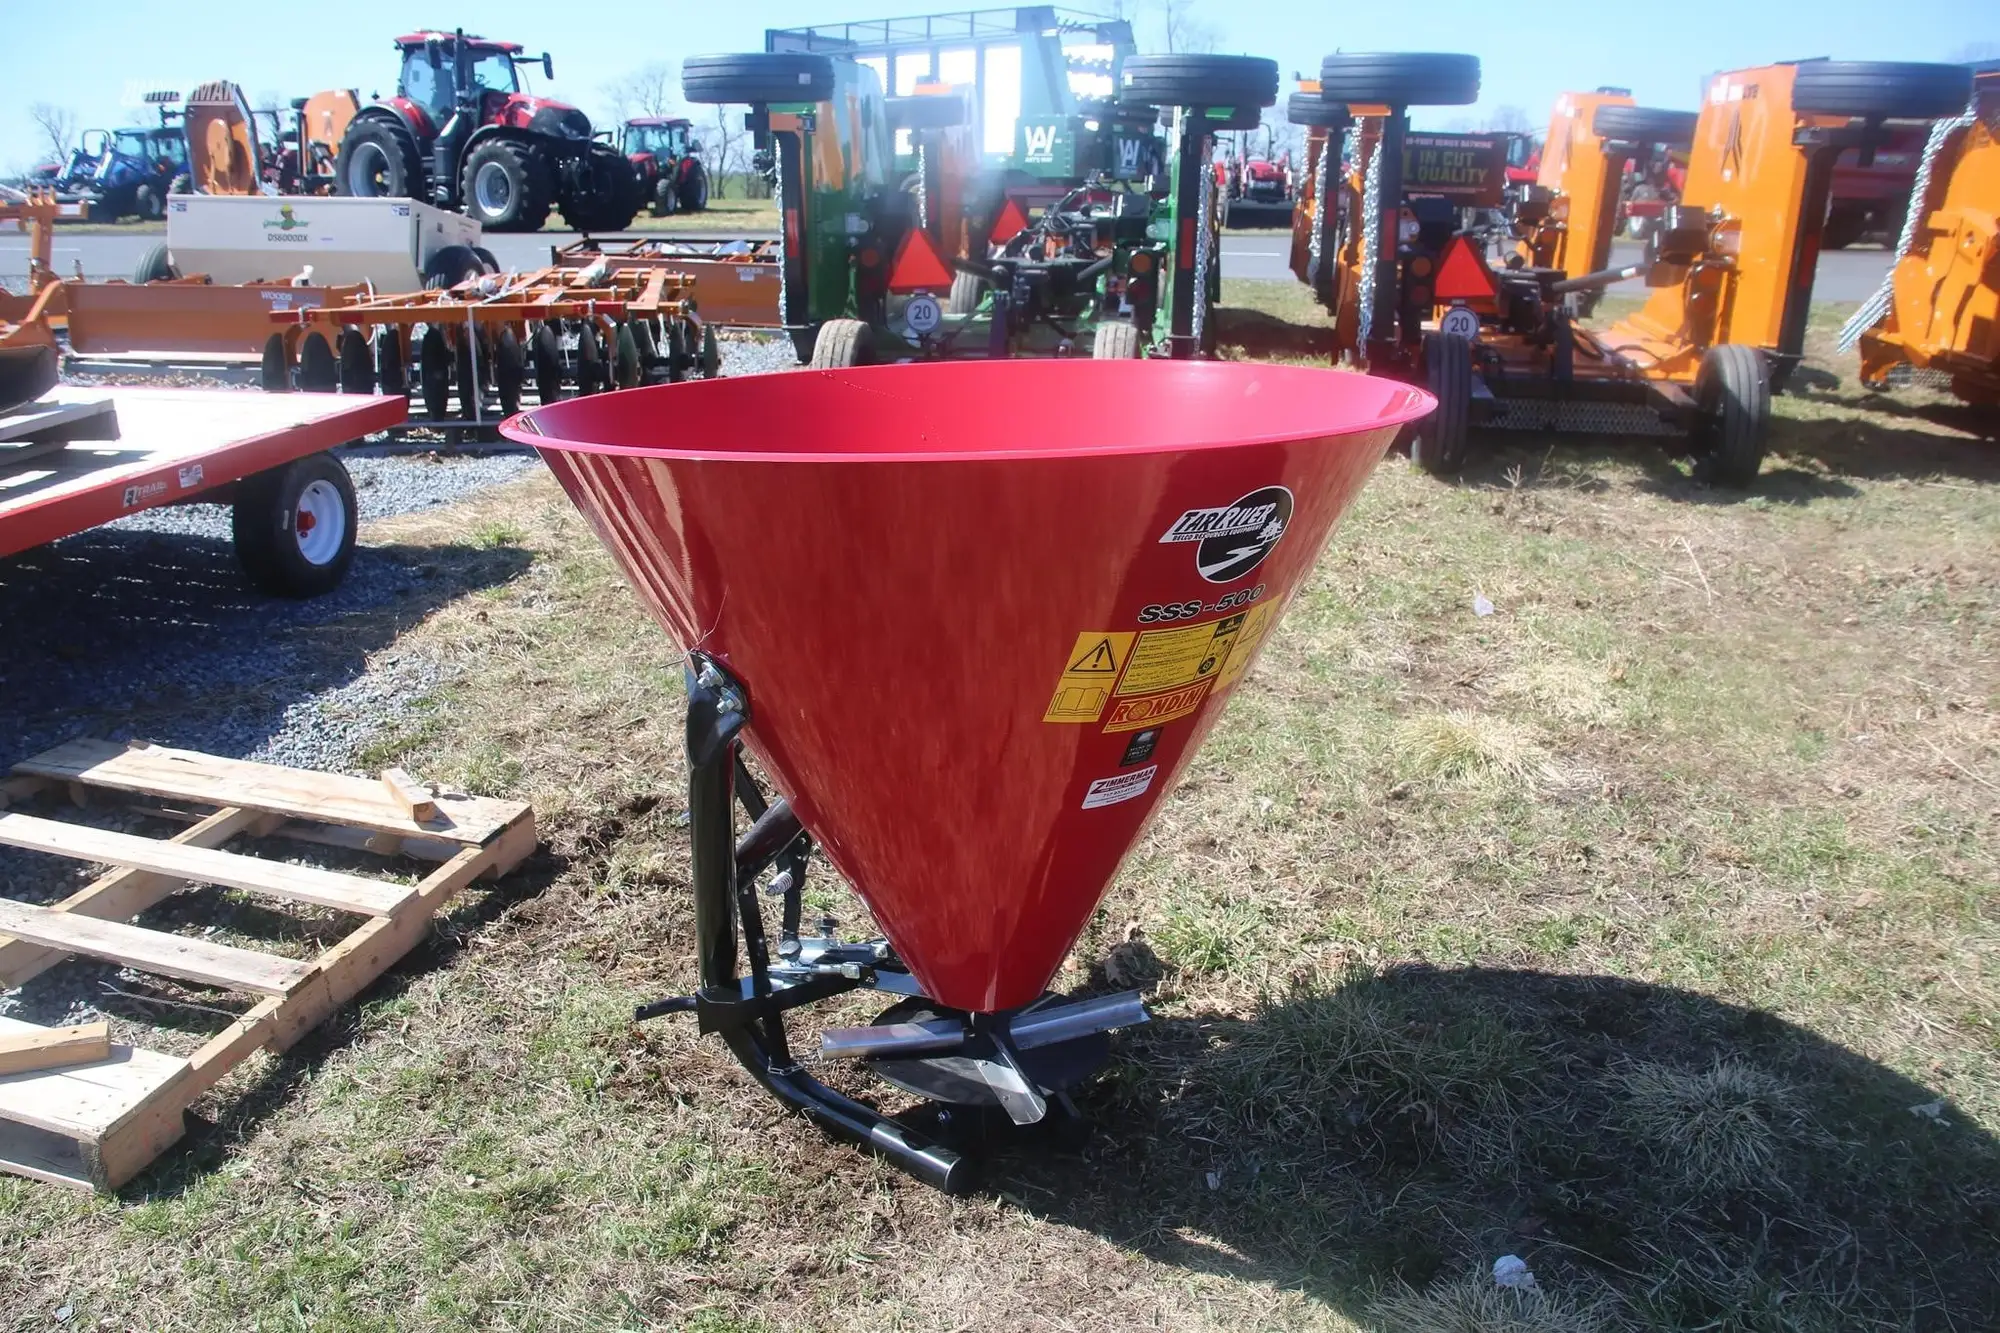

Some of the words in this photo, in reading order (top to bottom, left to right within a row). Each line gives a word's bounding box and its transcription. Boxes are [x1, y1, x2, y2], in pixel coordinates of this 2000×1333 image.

[1420, 150, 1437, 165] IN
[1443, 151, 1476, 167] CUT
[1418, 166, 1489, 184] QUALITY
[261, 290, 293, 301] WOODS
[913, 304, 932, 320] 20
[1450, 316, 1469, 332] 20
[1213, 502, 1277, 531] RIVER
[1193, 530, 1229, 540] RESOURCES
[1109, 684, 1207, 723] RONDINI
[1090, 767, 1155, 794] ZIMMERMAN
